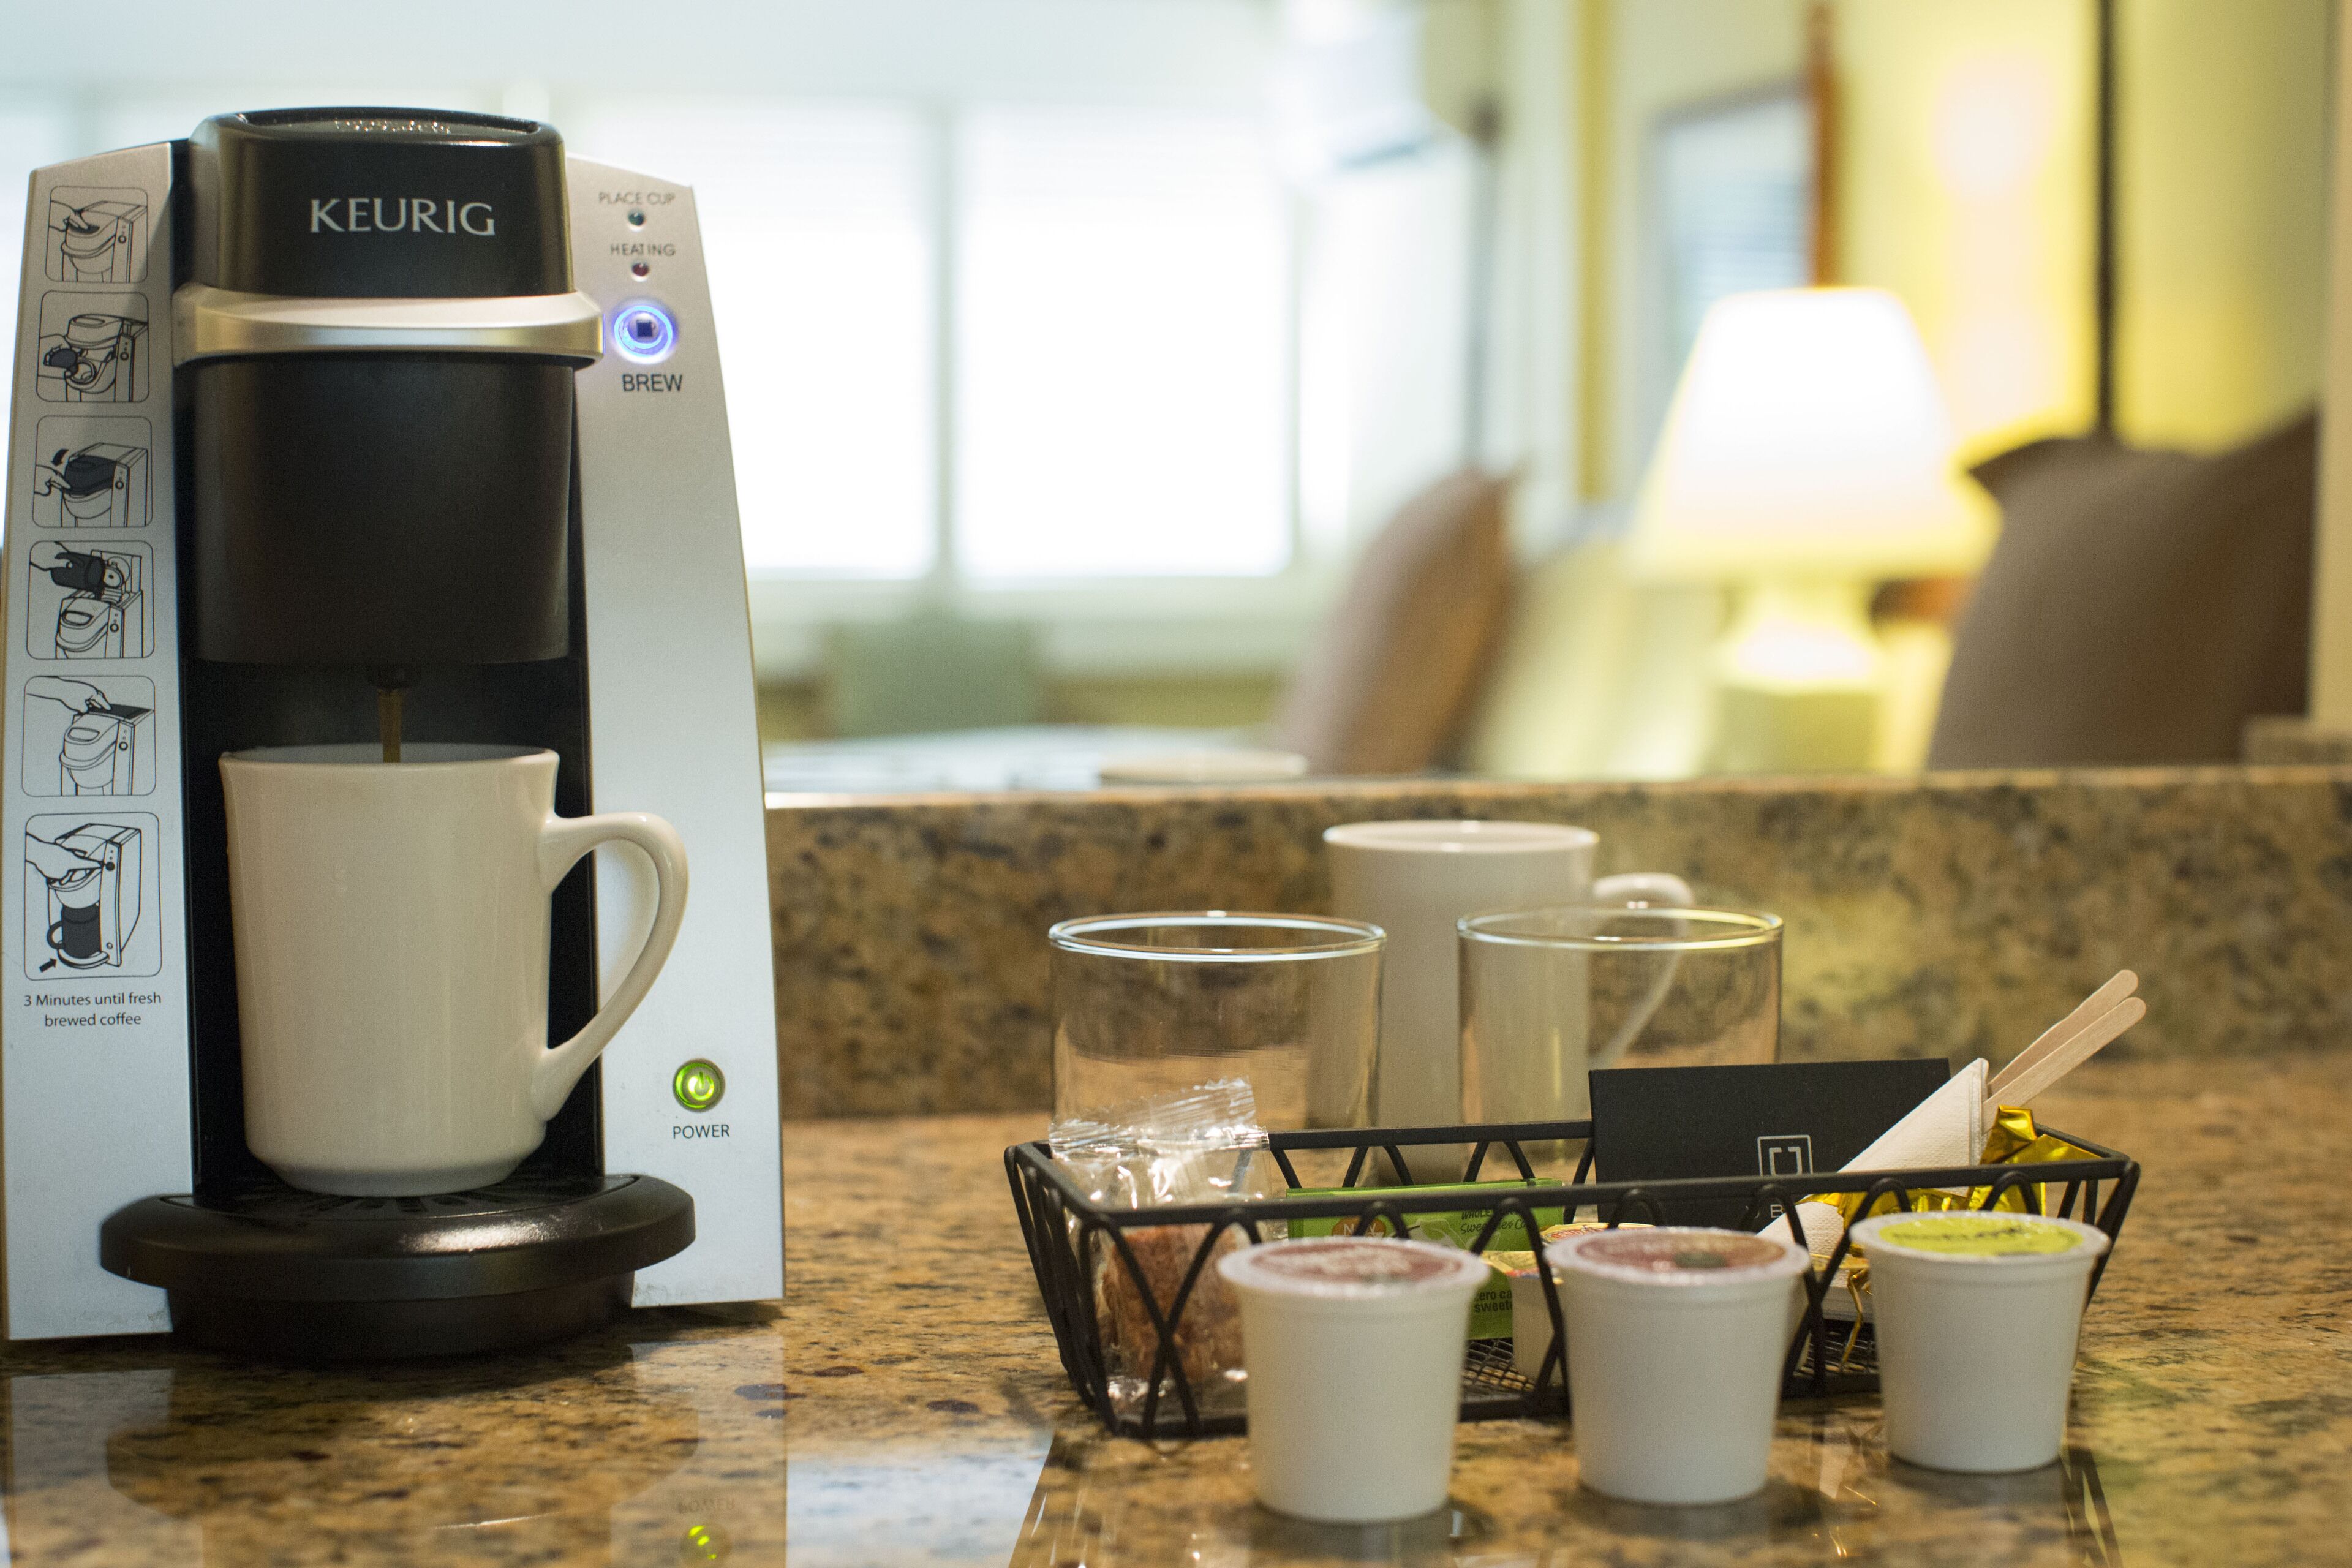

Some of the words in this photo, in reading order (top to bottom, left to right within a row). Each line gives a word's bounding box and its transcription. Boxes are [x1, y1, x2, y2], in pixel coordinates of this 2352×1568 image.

[598, 192, 642, 205] PLACE
[647, 192, 676, 205] CUP
[310, 198, 495, 236] KEURIG
[610, 244, 676, 257] HEATING
[622, 374, 683, 392] BREW
[24, 995, 31, 1006] 3
[36, 994, 91, 1006] Minutes
[95, 993, 125, 1005] until
[129, 992, 161, 1005] fresh
[45, 1013, 96, 1027] brewed
[100, 1012, 141, 1026] coffee
[673, 1124, 730, 1139] POWER
[1344, 1223, 1377, 1236] NW
[1474, 1300, 1512, 1313] sweet
